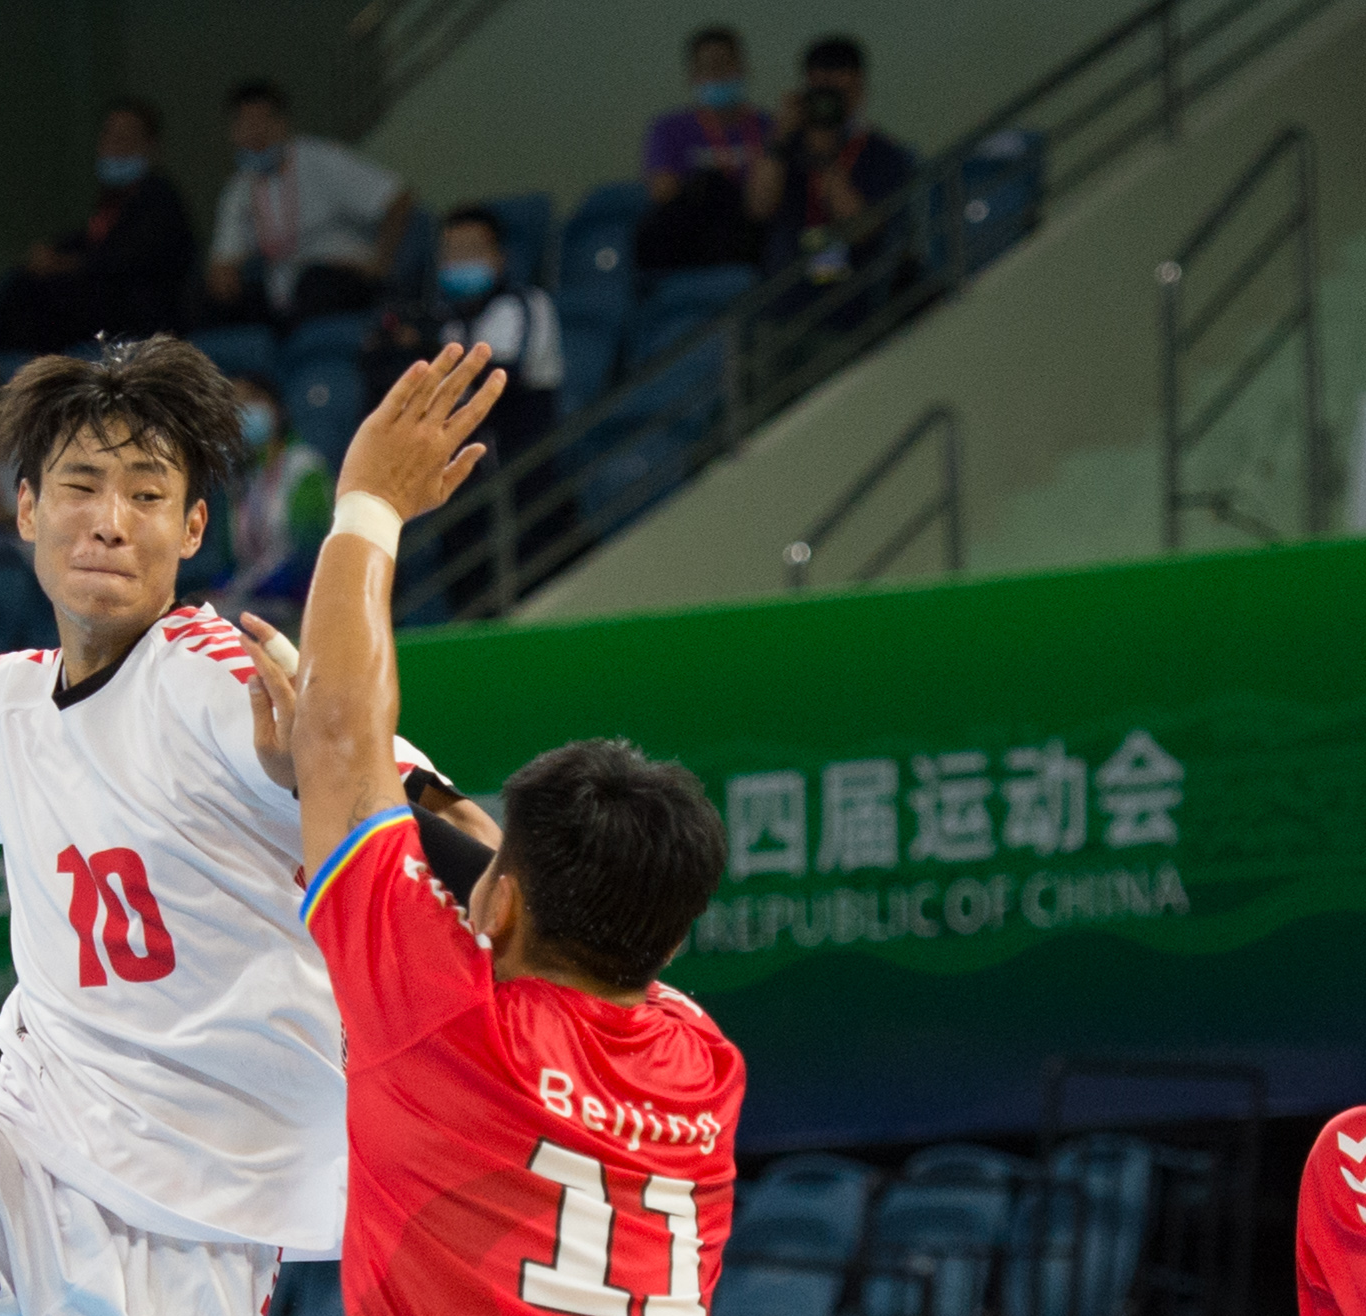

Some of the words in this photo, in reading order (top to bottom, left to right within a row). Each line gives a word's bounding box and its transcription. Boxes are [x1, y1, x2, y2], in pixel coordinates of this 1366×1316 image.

[725, 730, 1186, 880] 四届运动会
[56, 844, 177, 988] 10
[1021, 861, 1191, 930] CHINA
[538, 1067, 722, 1155] Beijing
